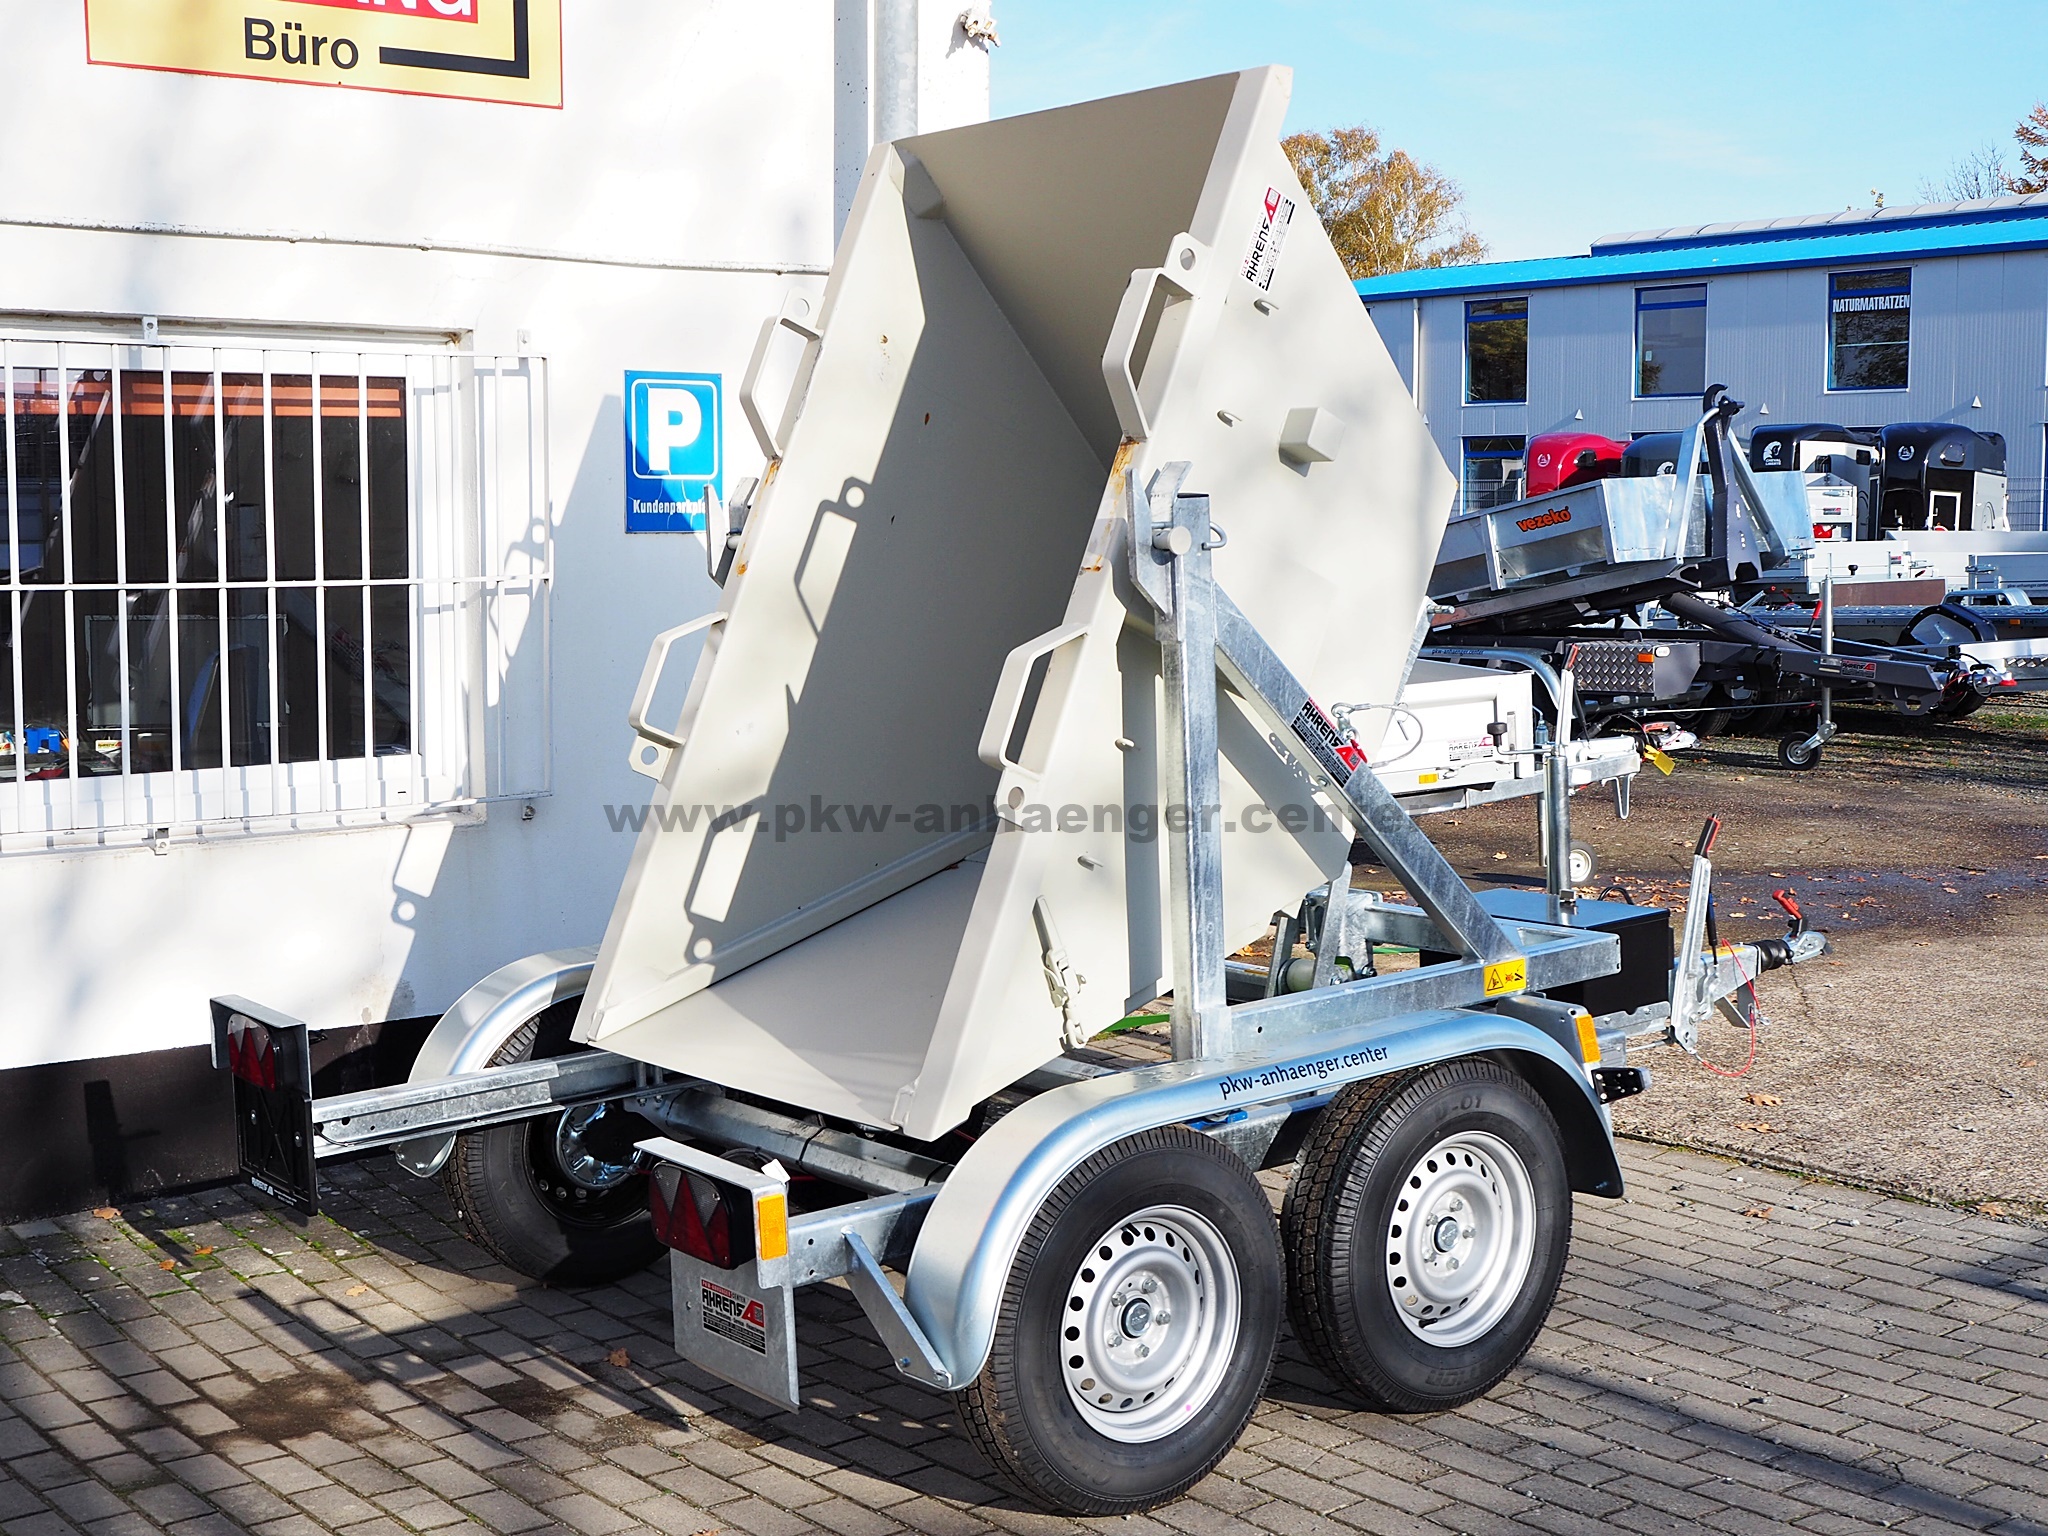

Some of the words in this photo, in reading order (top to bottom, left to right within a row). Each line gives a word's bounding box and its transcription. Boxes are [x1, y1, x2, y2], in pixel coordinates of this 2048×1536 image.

[244, 16, 359, 70] Büro
[1245, 216, 1270, 282] AHRENS
[1832, 294, 1911, 313] NATURMATRATZEN
[648, 387, 702, 471] P
[633, 499, 706, 517] Kundenparkpla
[1516, 507, 1571, 532] vezeko
[1301, 700, 1344, 748] AHRENS
[1219, 1046, 1389, 1100] pkw-anhaenger.center
[702, 1287, 746, 1317] AHRENS
